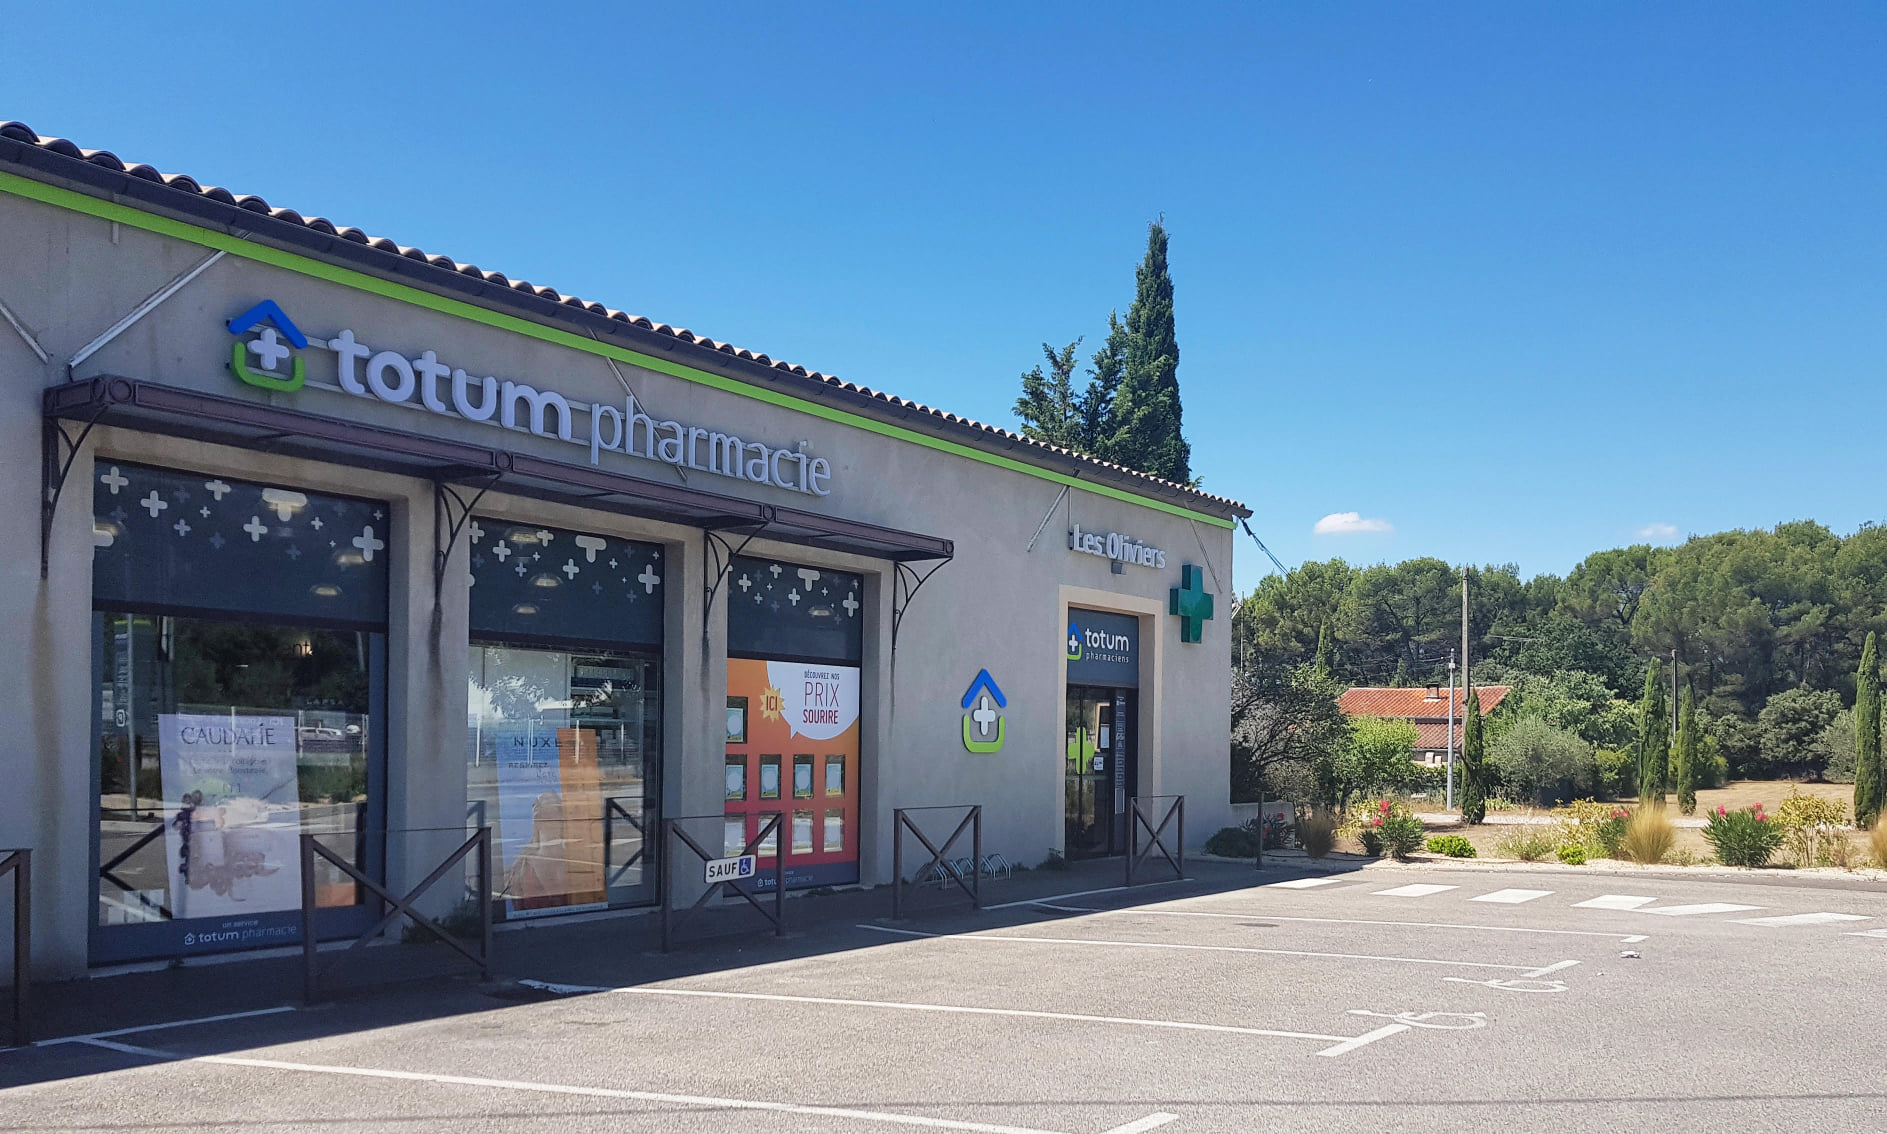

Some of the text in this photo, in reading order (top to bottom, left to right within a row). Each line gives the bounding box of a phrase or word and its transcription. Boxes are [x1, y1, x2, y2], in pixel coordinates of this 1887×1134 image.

[328, 328, 833, 497] totum pharmacie
[1073, 523, 1165, 569] Les Oliviers
[1085, 628, 1129, 652] totum
[1085, 651, 1129, 663] pharmaciens
[831, 673, 840, 681] NOS
[766, 695, 778, 711] ICI
[804, 681, 840, 708] PRIX
[803, 709, 839, 725] SOURIRE
[708, 862, 738, 878] SAUF
[198, 925, 297, 943] totum pharmacie
